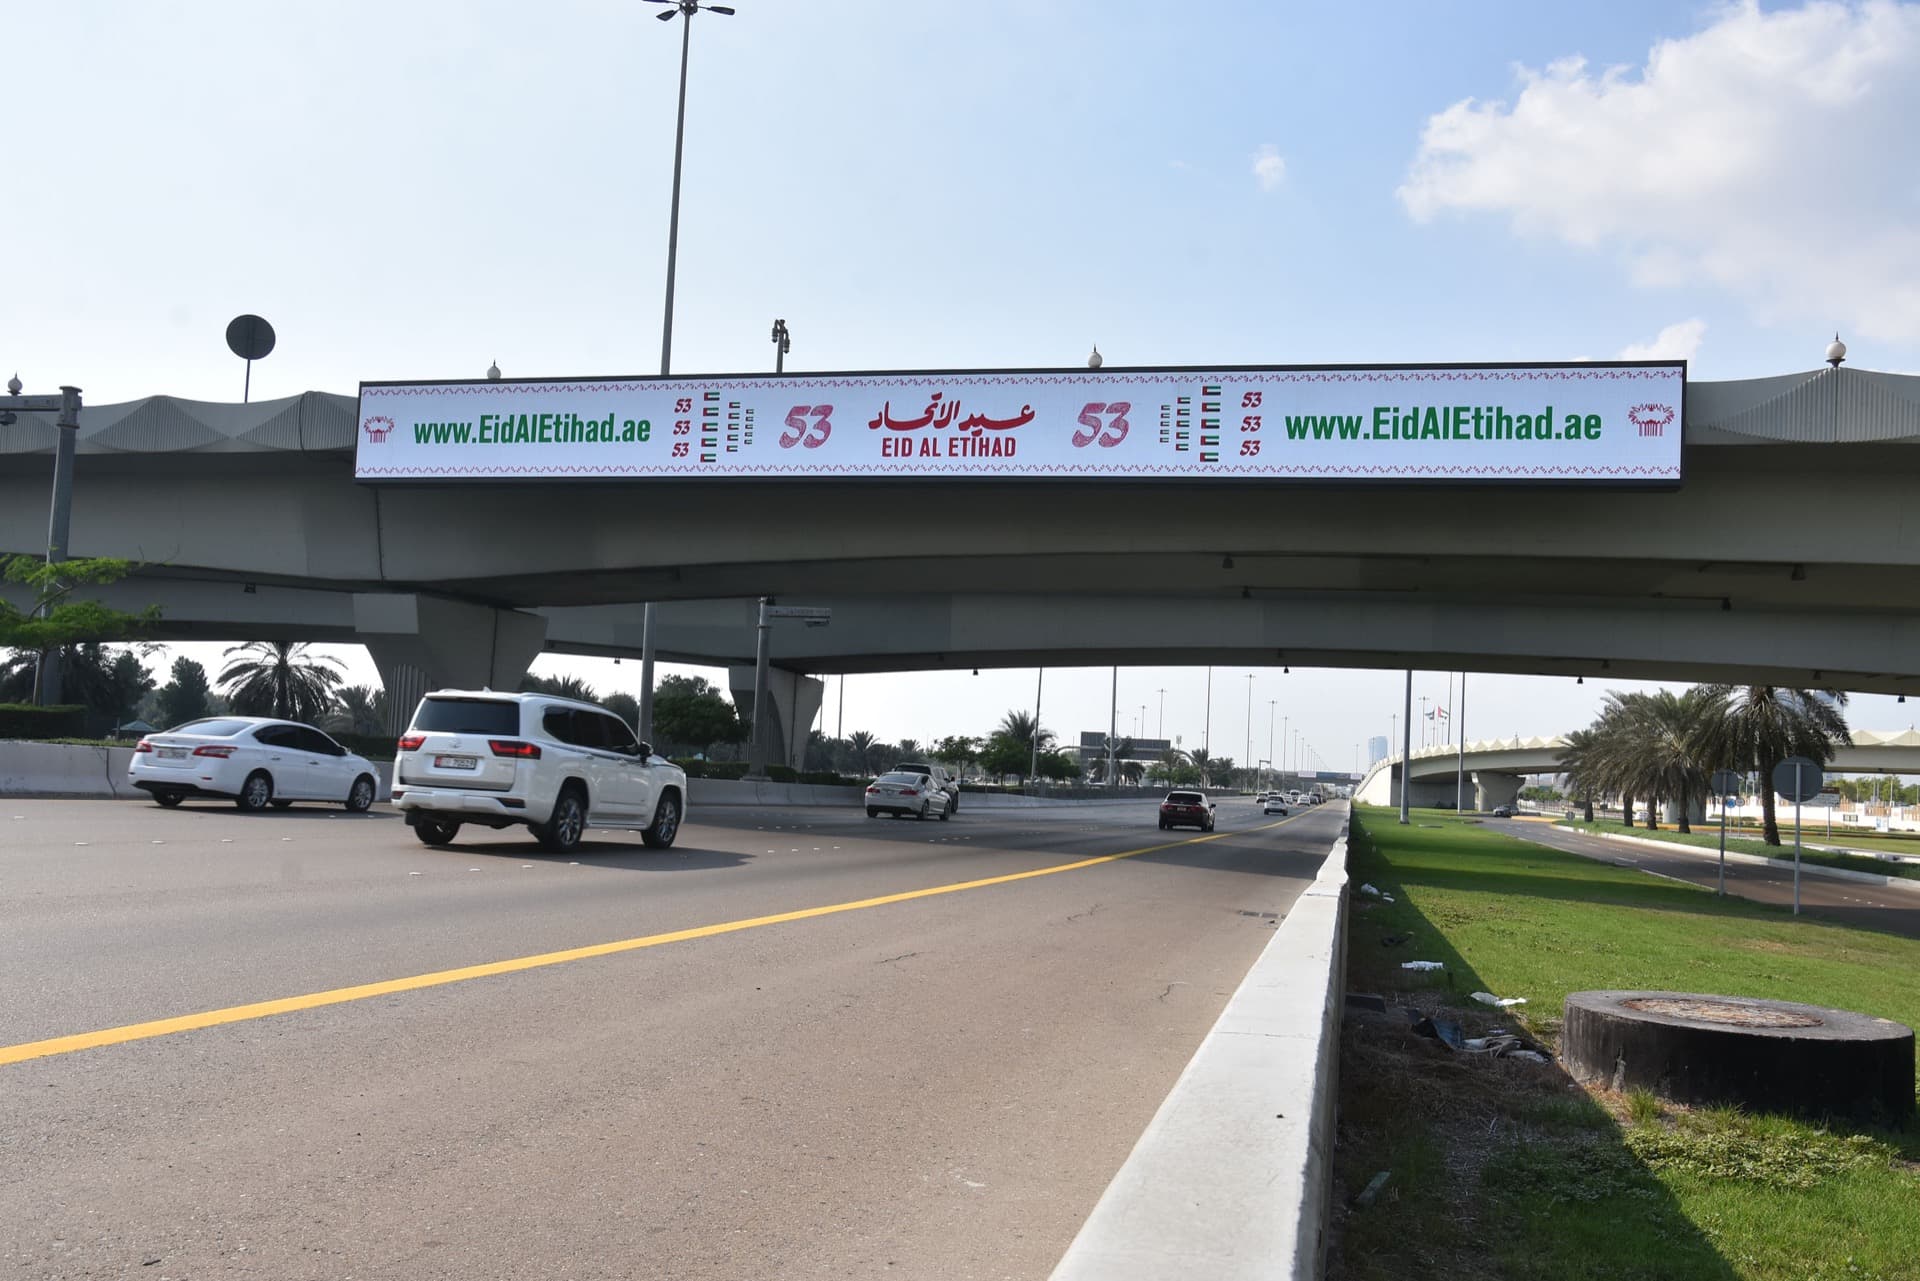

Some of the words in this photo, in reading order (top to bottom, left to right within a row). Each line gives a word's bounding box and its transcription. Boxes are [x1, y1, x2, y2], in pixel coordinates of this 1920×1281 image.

[674, 398, 693, 413] 53
[1241, 391, 1262, 408] 53
[868, 391, 960, 431] الاتحاد
[958, 404, 1035, 437] عيد
[414, 412, 651, 444] www.EidAlEtihad.ae
[673, 420, 691, 435] 53
[779, 404, 834, 449] 53
[1071, 401, 1132, 448] 53
[1240, 415, 1261, 432] 53
[1285, 405, 1602, 441] www.EidAlEtihad.ae
[672, 442, 689, 458] 53
[882, 438, 913, 457] EID
[919, 438, 942, 457] AL
[948, 438, 1016, 457] ETIHAD
[1239, 439, 1260, 457] 53
